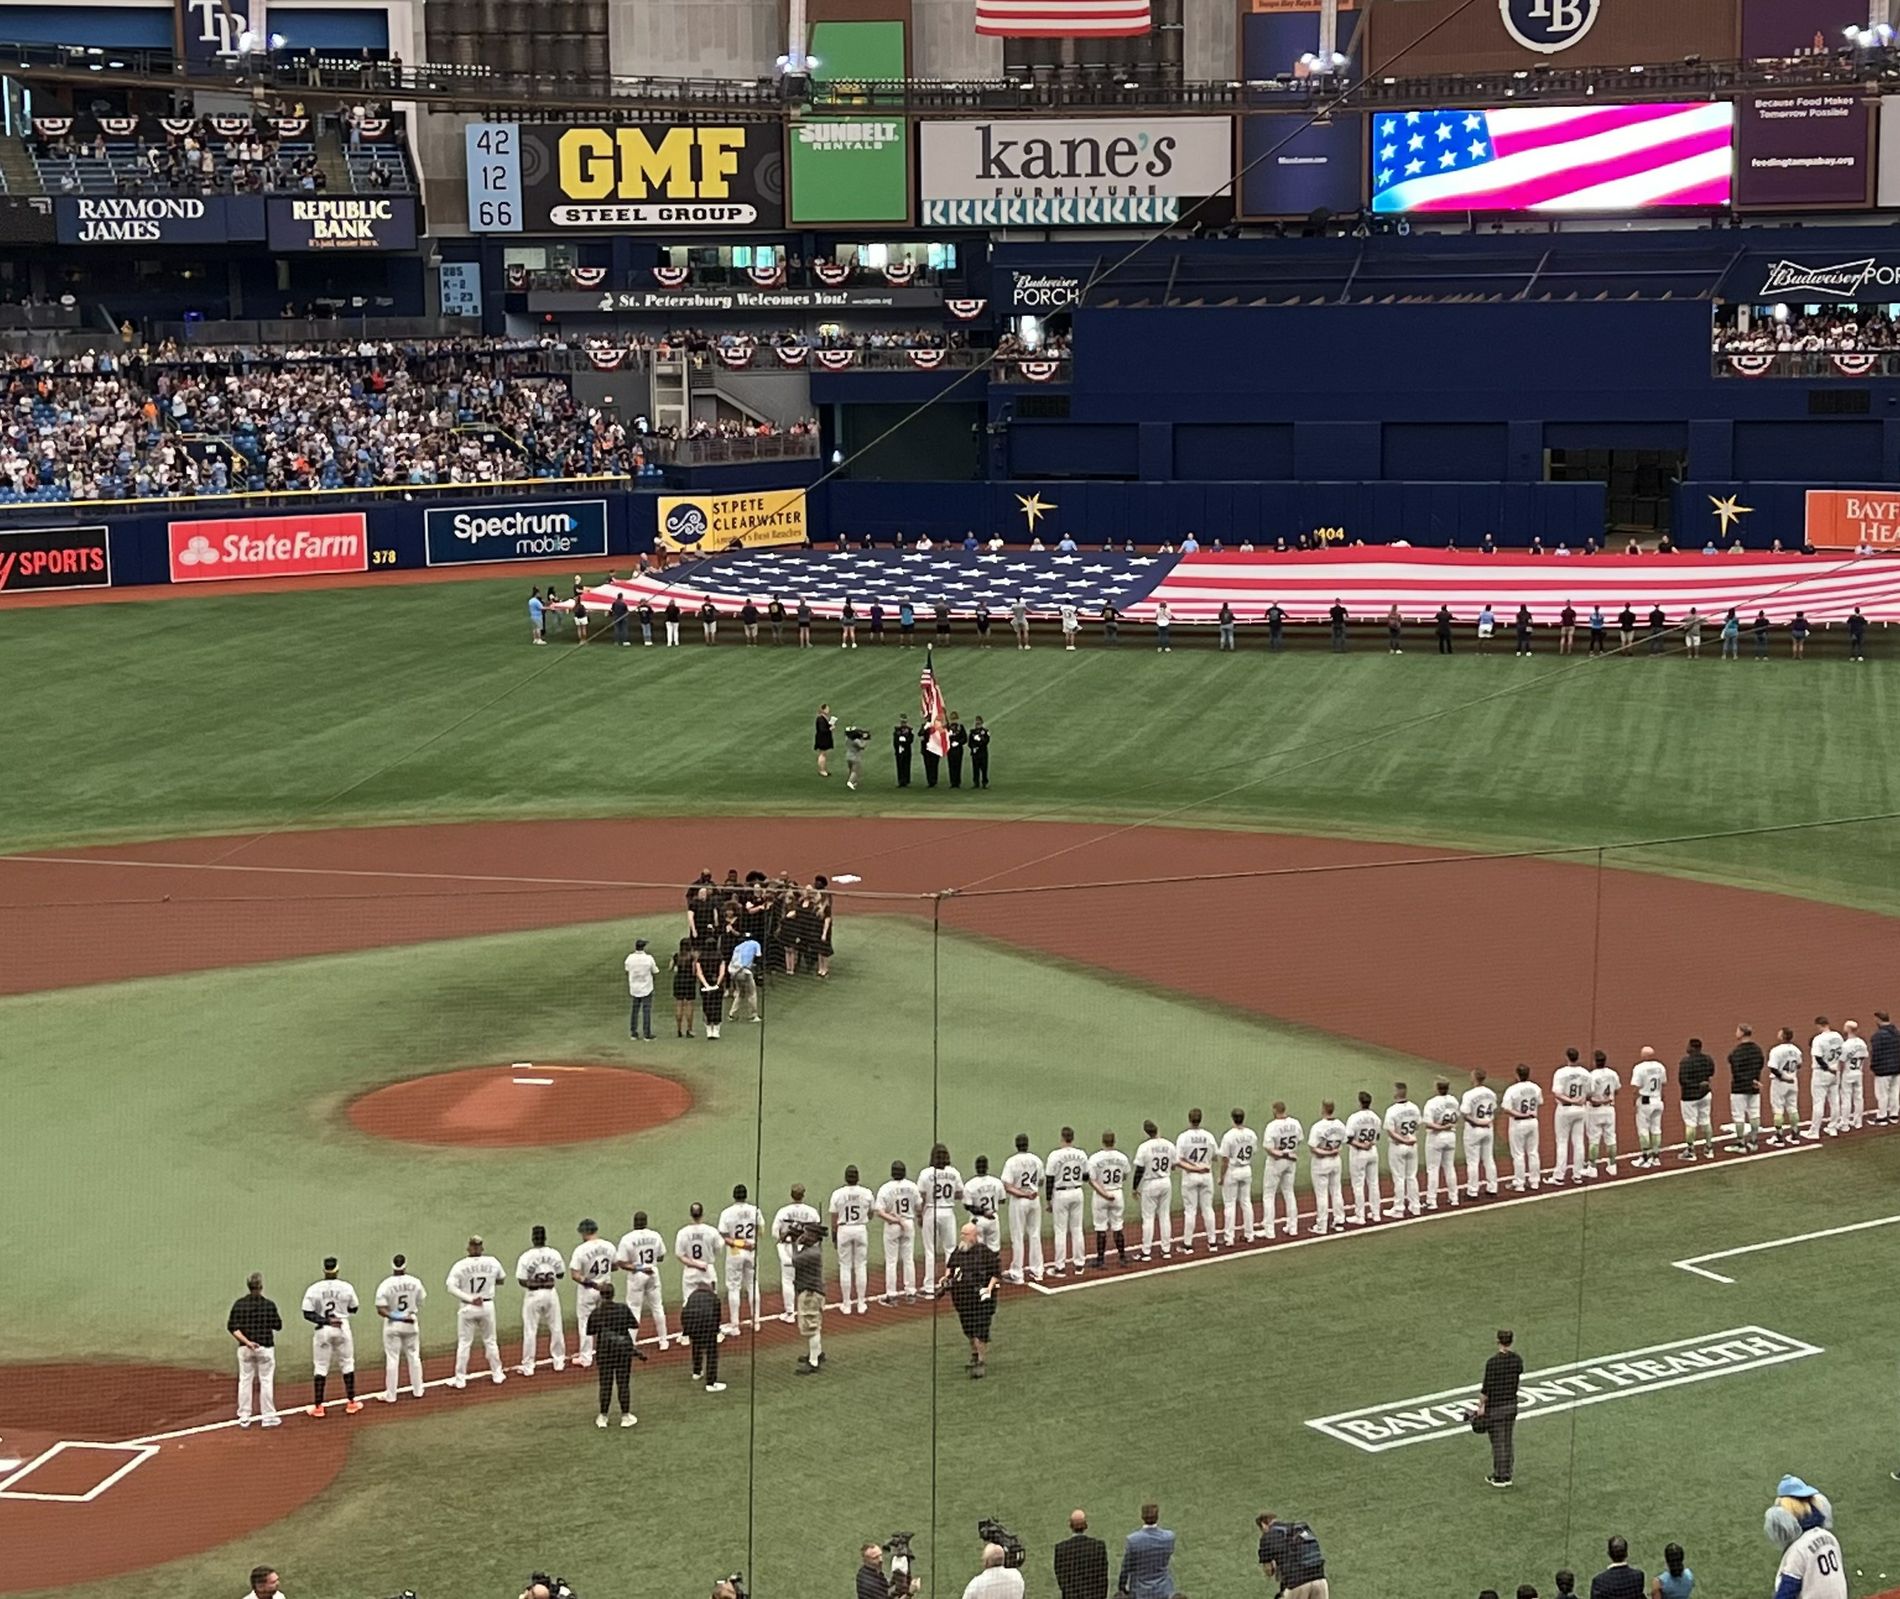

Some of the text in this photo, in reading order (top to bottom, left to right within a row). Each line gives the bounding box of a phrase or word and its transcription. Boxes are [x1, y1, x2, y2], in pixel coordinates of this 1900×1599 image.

[1797, 97, 1822, 106] Food
[477, 130, 510, 155] 42
[812, 142, 883, 150] RENTALS
[975, 124, 1177, 180] kane's
[558, 127, 746, 200] GMF
[482, 166, 507, 190] 12
[994, 184, 1157, 199] FURNITURE
[78, 198, 205, 219] RAYMOND
[292, 200, 393, 220] REPUBLIC
[479, 201, 513, 226] 66
[566, 207, 743, 222] STEEL GROUP
[78, 219, 161, 241] JAMES
[313, 219, 374, 238] BANK
[1773, 268, 1862, 286] Budweiser
[619, 294, 640, 307] St.
[644, 294, 733, 309] Petersburg
[736, 292, 810, 306] Welcomes
[814, 292, 848, 305] You!
[1013, 288, 1080, 305] PORCH
[454, 512, 570, 544] Spectrum
[713, 511, 802, 531] CLEARWATER
[1318, 527, 1345, 540] 404
[516, 536, 571, 554] mobile
[19, 547, 105, 576] SPORTS
[372, 551, 397, 564] 378
[1569, 1083, 1583, 1098] 81
[1476, 1103, 1493, 1119] 64
[1359, 1128, 1376, 1143] 58
[1400, 1120, 1417, 1136] 59
[1279, 1135, 1298, 1151] 55
[1188, 1147, 1208, 1163] 47
[1236, 1145, 1253, 1161] 49
[1151, 1156, 1170, 1173] 38
[1020, 1171, 1038, 1187] 24
[1062, 1165, 1082, 1182] 29
[1102, 1168, 1122, 1185] 36
[934, 1182, 953, 1199] 20
[895, 1197, 910, 1214] 19
[979, 1196, 996, 1211] 21
[844, 1204, 861, 1222] 15
[734, 1222, 755, 1239] 22
[638, 1247, 655, 1265] 13
[691, 1243, 703, 1260] 8
[589, 1257, 610, 1277] 43
[469, 1276, 488, 1294] 17
[325, 1301, 337, 1317] 2
[396, 1294, 409, 1312] 5
[1587, 1336, 1790, 1386] HEALTH
[1817, 1549, 1838, 1576] 00
